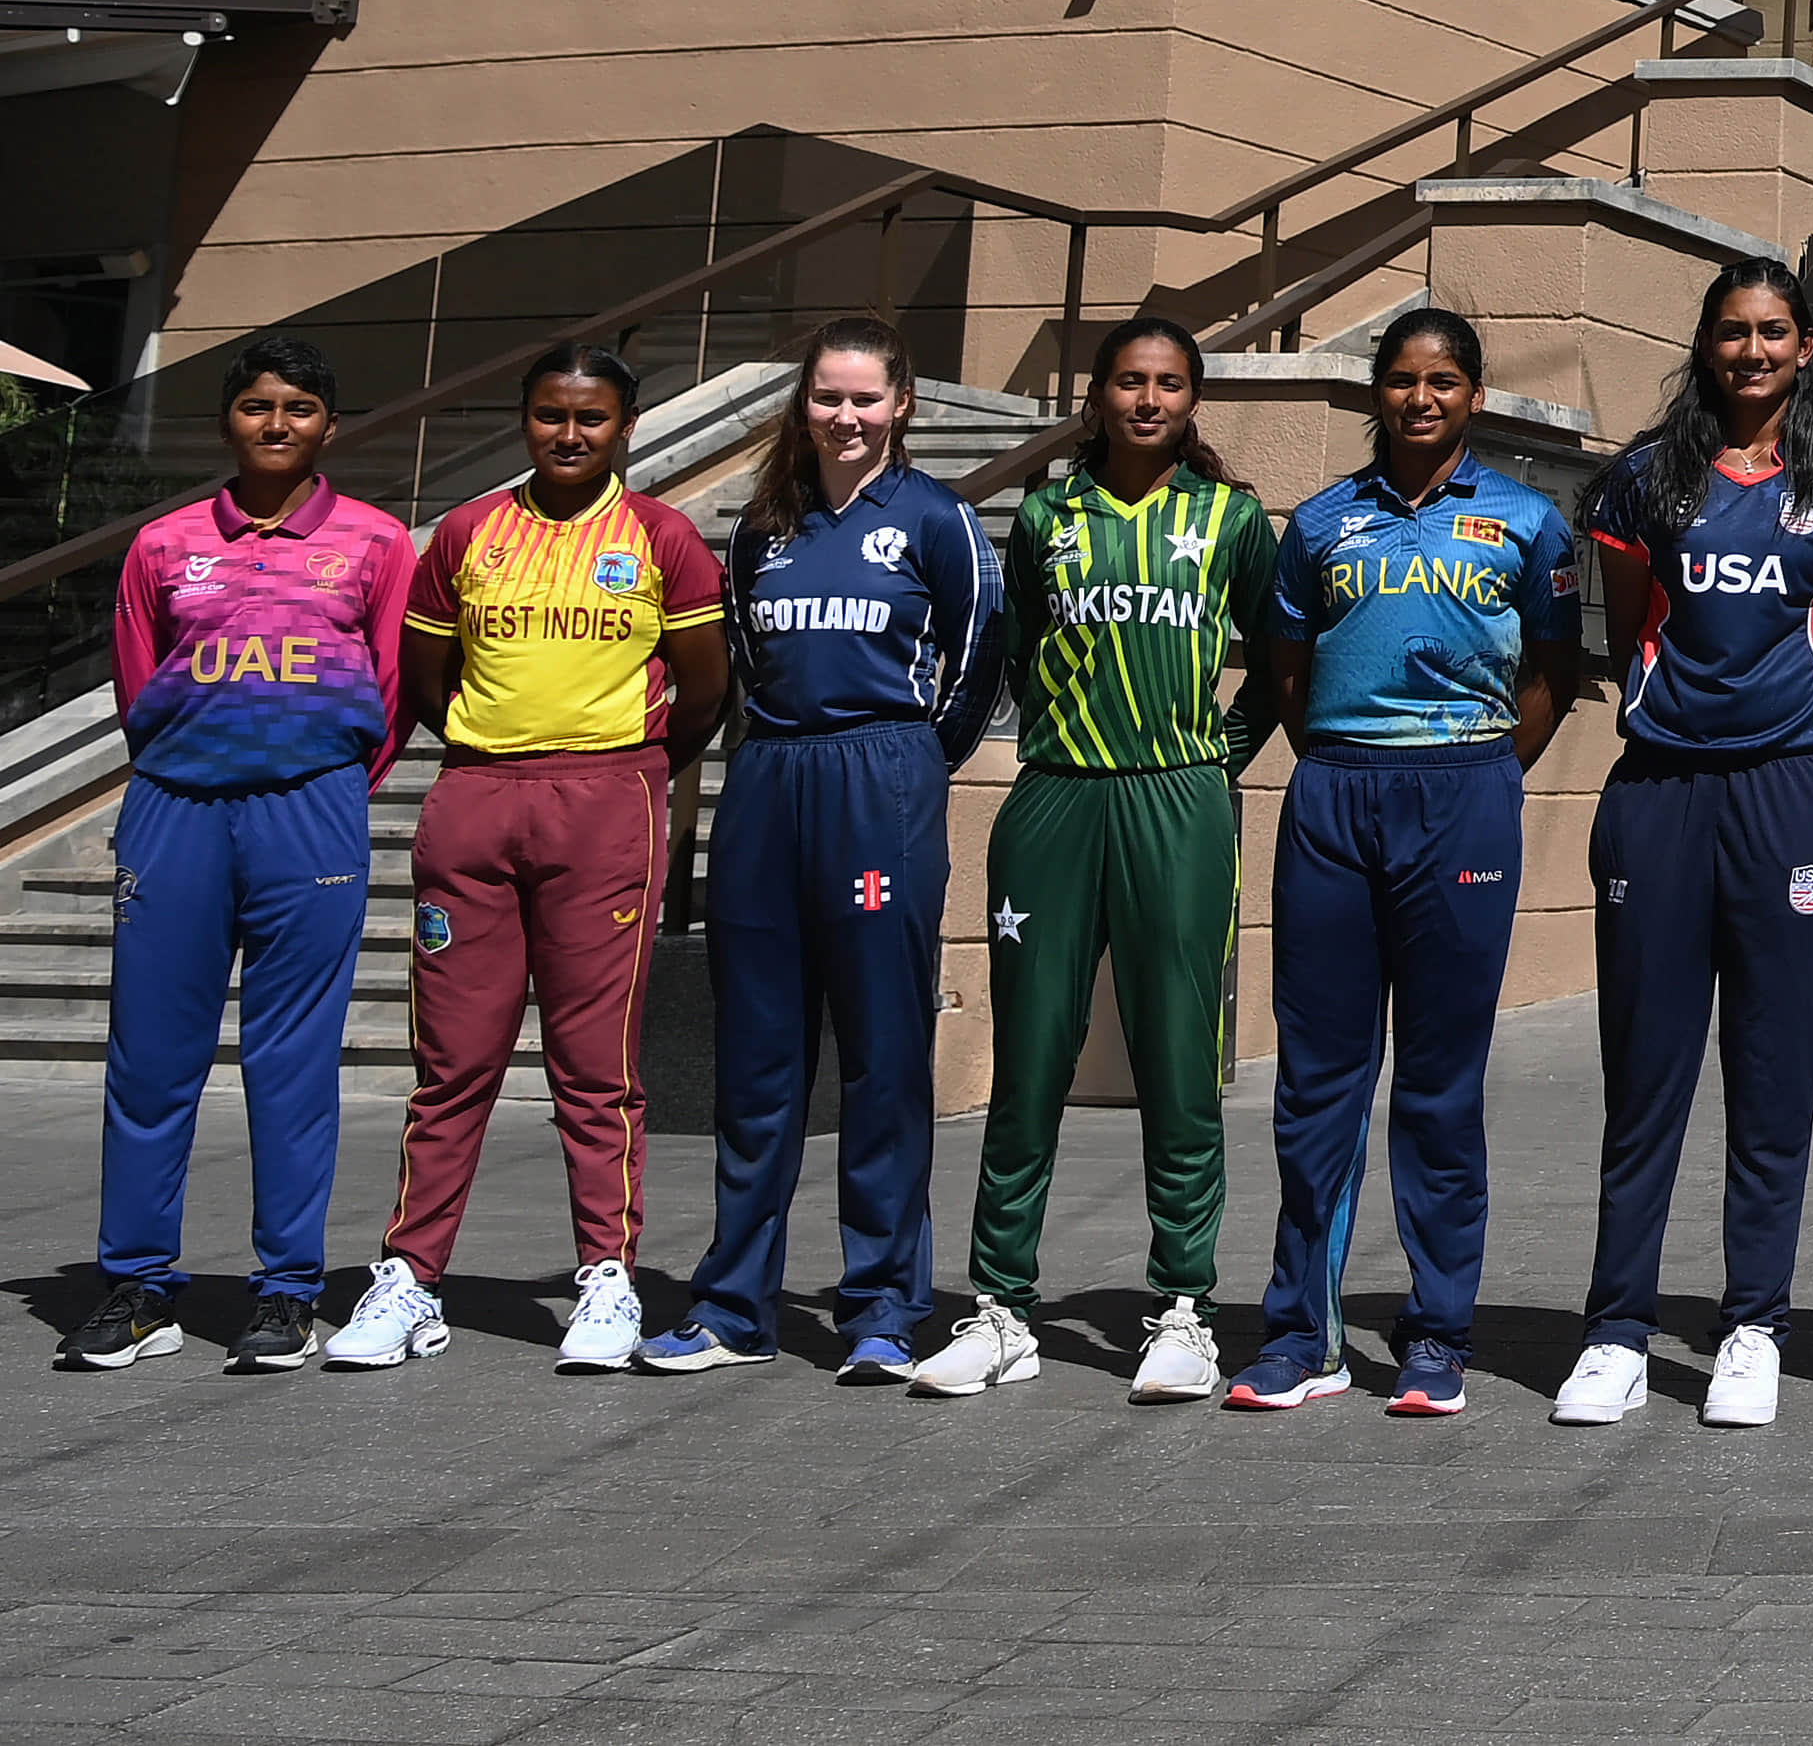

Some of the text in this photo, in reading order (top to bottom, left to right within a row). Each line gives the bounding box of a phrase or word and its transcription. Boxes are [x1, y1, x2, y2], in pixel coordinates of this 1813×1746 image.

[1320, 555, 1508, 609] SRI LANKA
[1680, 552, 1788, 596] USA
[467, 604, 633, 641] WEST INDIES
[749, 596, 892, 633] SCOTLAND
[190, 635, 319, 684] UAE
[1472, 869, 1503, 884] MAS
